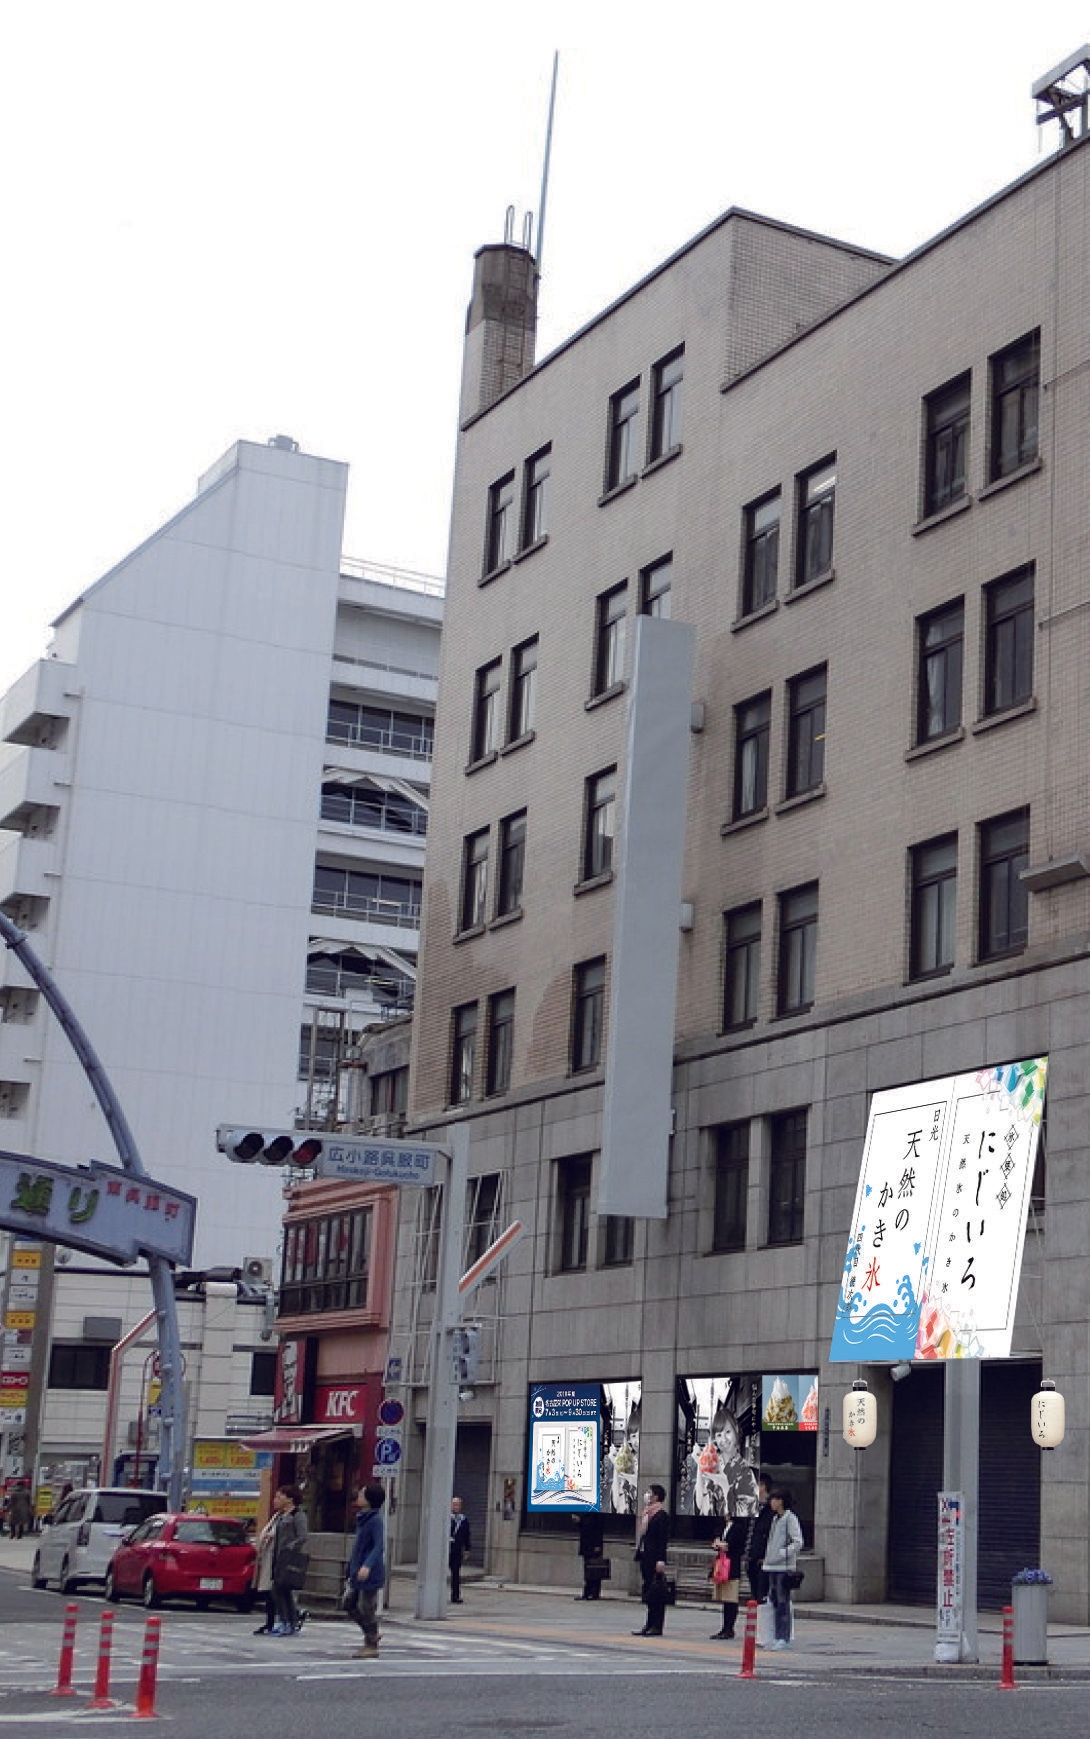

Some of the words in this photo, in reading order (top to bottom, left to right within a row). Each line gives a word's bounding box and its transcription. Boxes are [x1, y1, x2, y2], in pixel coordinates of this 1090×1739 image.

[928, 1108, 941, 1142] 日光
[894, 1129, 923, 1232] 天然の
[941, 1133, 971, 1294] 天然氷のかき氷
[960, 1130, 997, 1291] にじいろ
[860, 1181, 894, 1293] かき氷
[325, 1390, 360, 1417] KFC
[561, 1399, 572, 1407] POP
[573, 1399, 580, 1407] UP
[580, 1398, 597, 1407] STORE
[856, 1397, 865, 1425] 天然の
[1038, 1401, 1046, 1439] にじいろ
[848, 1411, 856, 1437] かき氷
